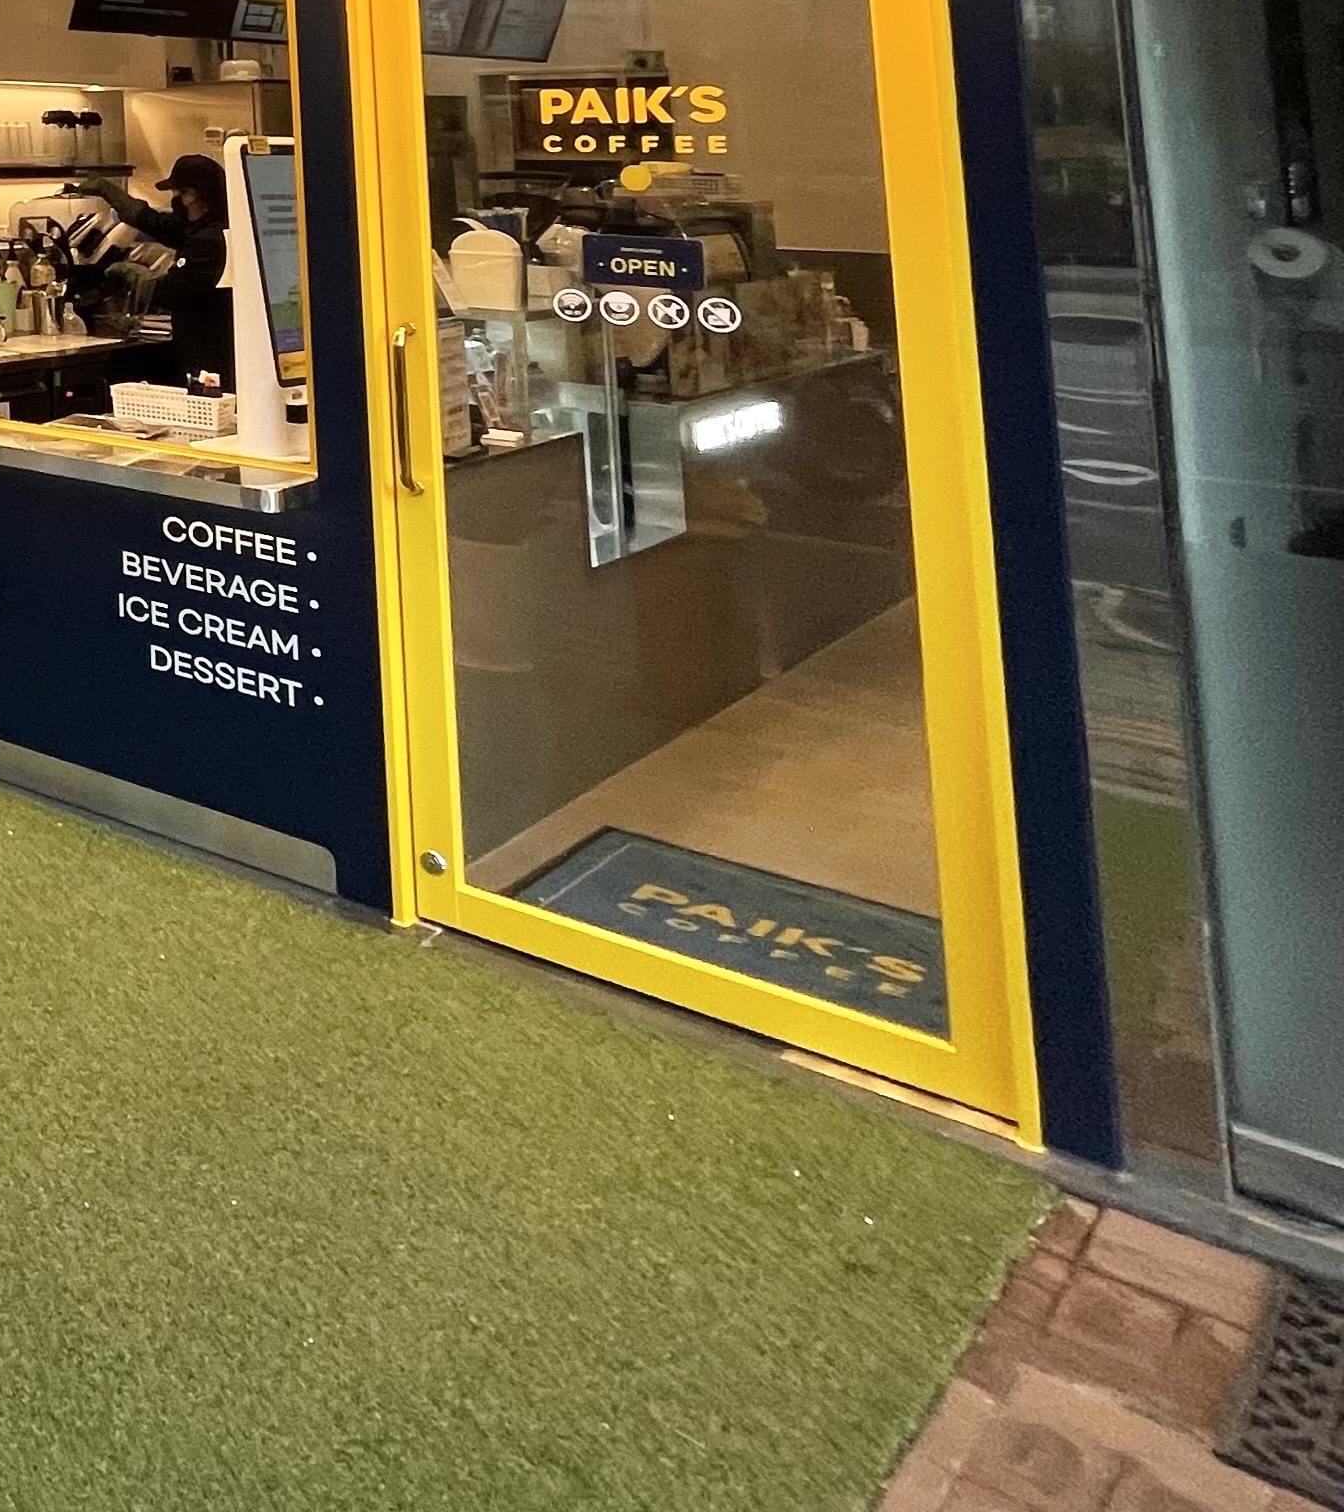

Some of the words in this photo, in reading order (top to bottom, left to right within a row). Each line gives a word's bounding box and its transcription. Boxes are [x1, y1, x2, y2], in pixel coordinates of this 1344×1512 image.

[539, 84, 728, 124] PAIK'S
[543, 134, 729, 154] COFFEE
[610, 257, 676, 277] OPEN
[162, 516, 297, 566] COFFEE
[122, 550, 300, 614] BEVERAGE
[118, 592, 171, 629] ICE
[178, 608, 300, 661] CREAM
[150, 644, 304, 707] DESSERT
[629, 882, 926, 984] PAIK'S
